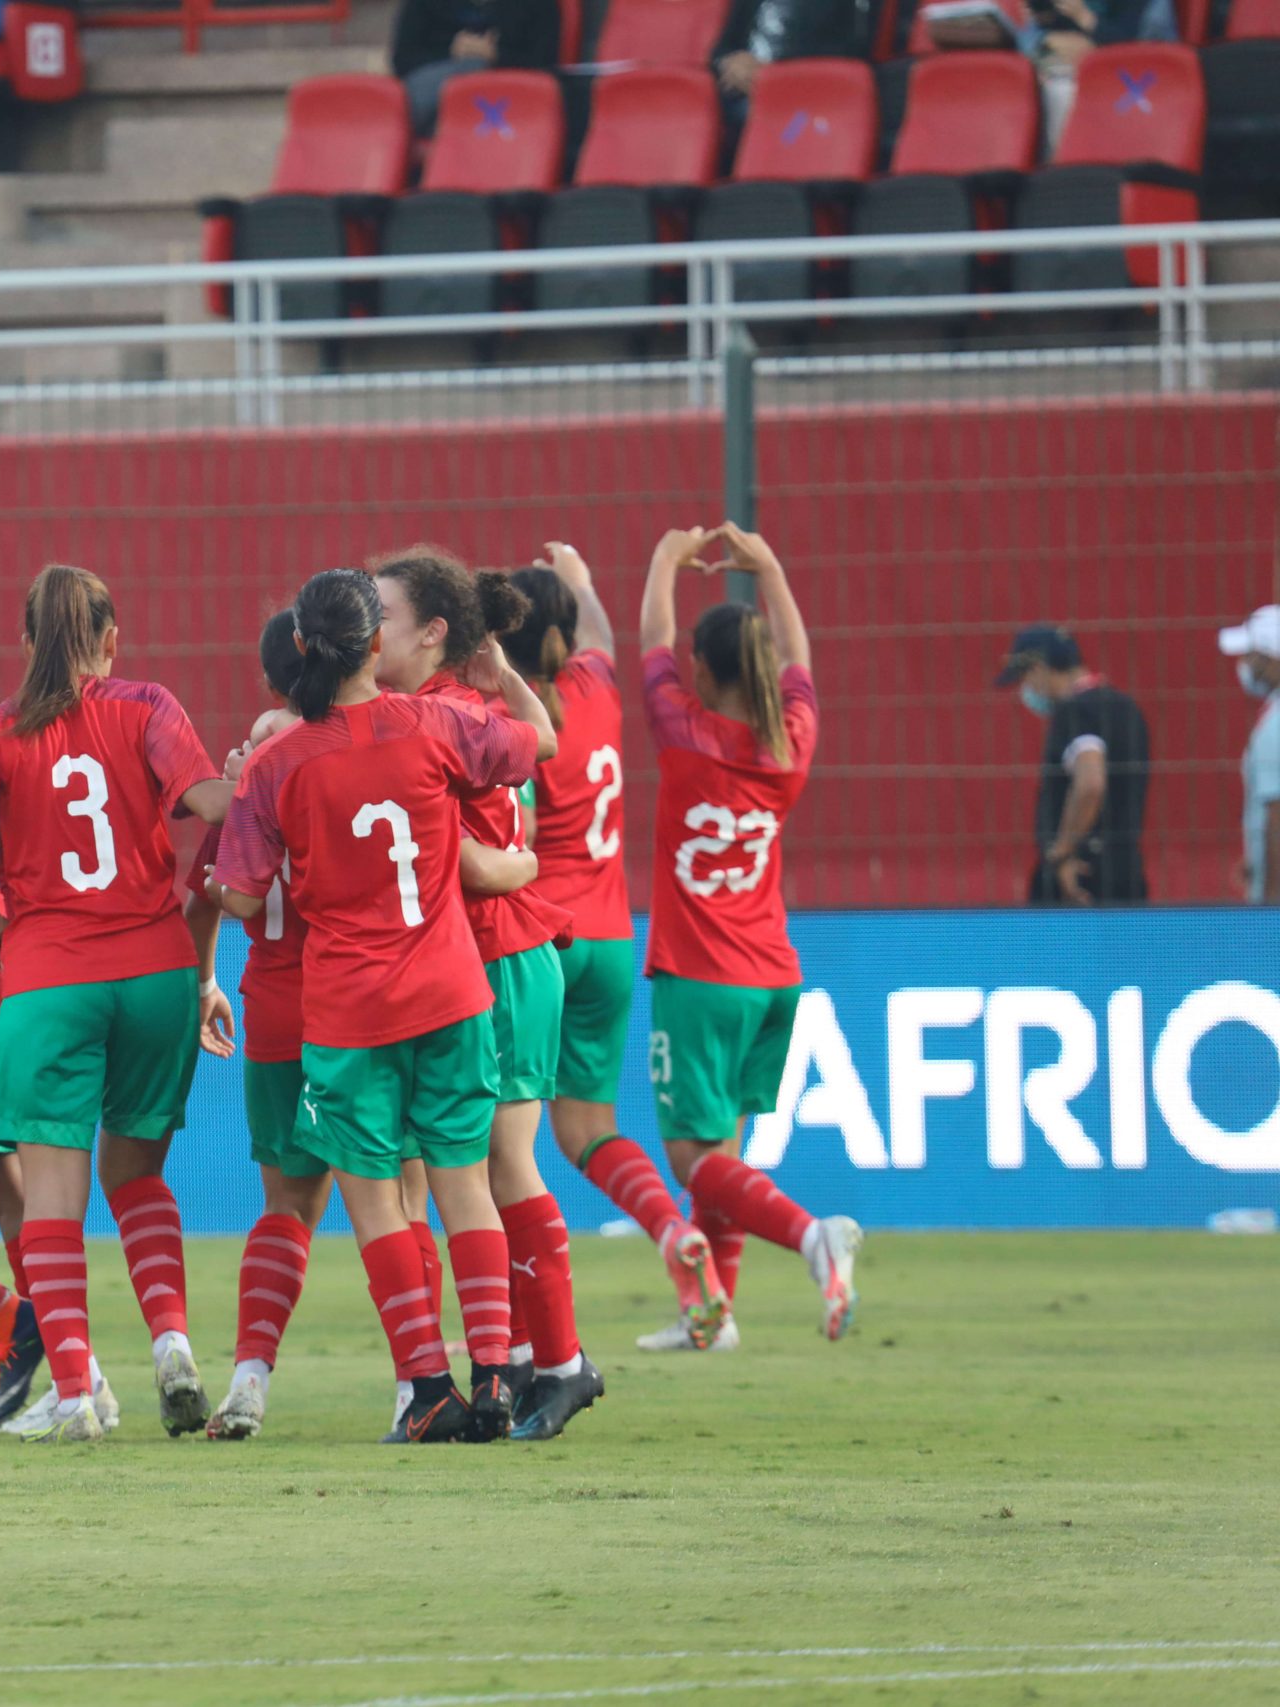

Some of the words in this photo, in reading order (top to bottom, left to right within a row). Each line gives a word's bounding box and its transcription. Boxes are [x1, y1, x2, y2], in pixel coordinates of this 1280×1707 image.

[52, 753, 118, 892] 3
[351, 799, 425, 927] 7
[586, 744, 623, 861] 2
[675, 802, 779, 898] 23
